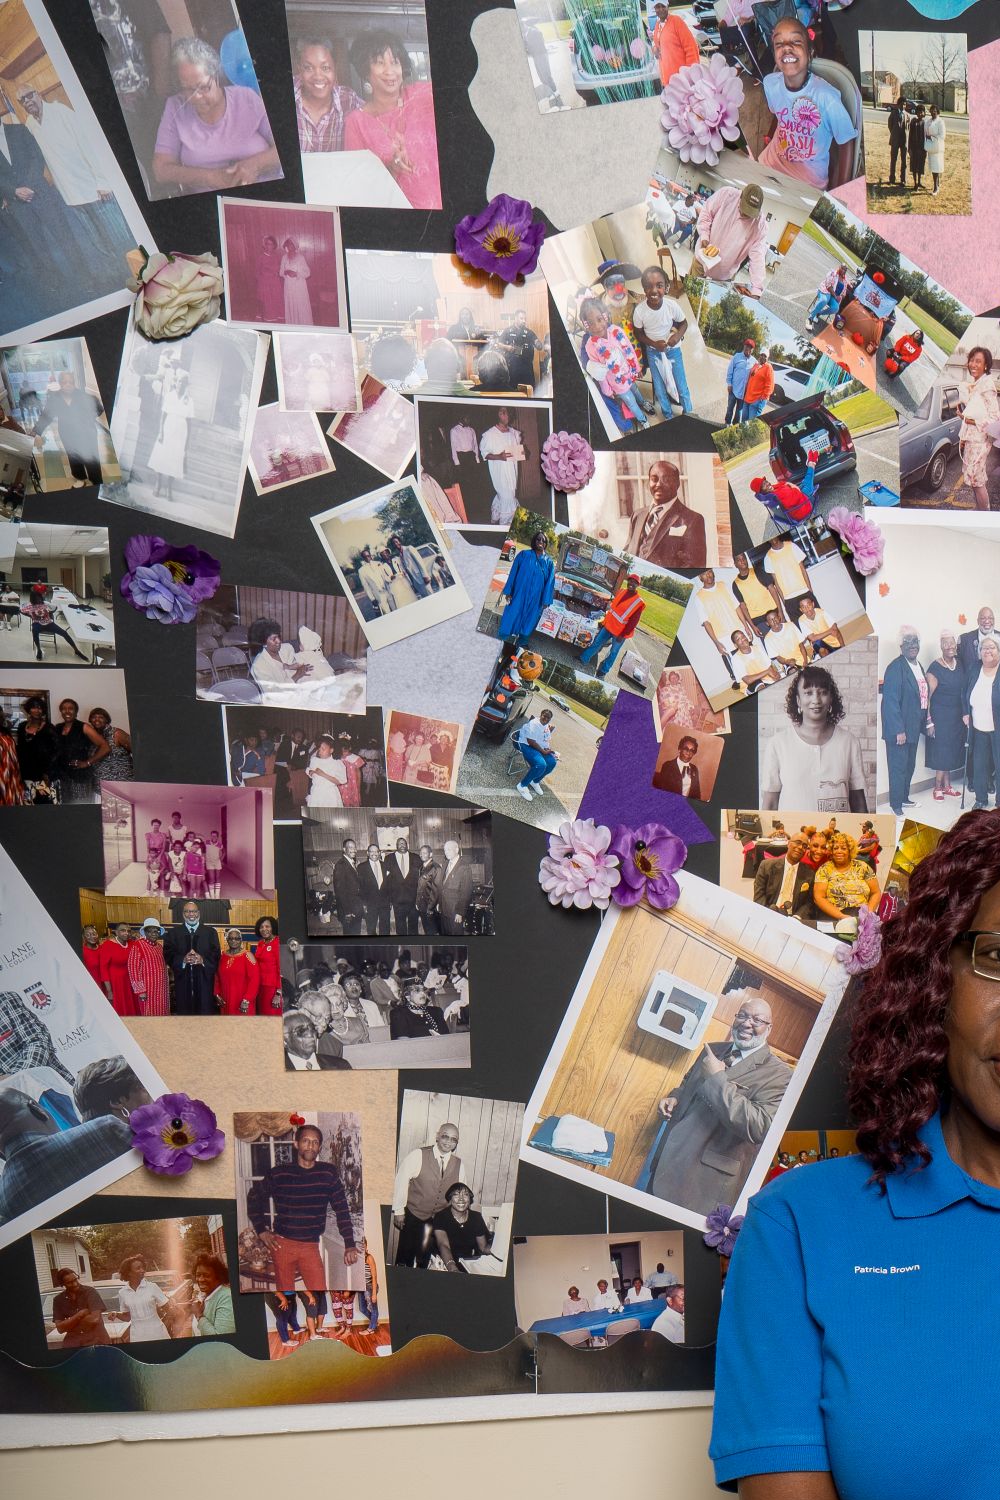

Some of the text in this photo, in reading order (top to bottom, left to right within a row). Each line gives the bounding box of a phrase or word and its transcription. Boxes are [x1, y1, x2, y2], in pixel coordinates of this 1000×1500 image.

[3, 941, 34, 963] LANE
[9, 950, 37, 969] COLLEGE
[58, 1025, 89, 1046] LANE
[854, 1264, 920, 1275] Patricia Brown
